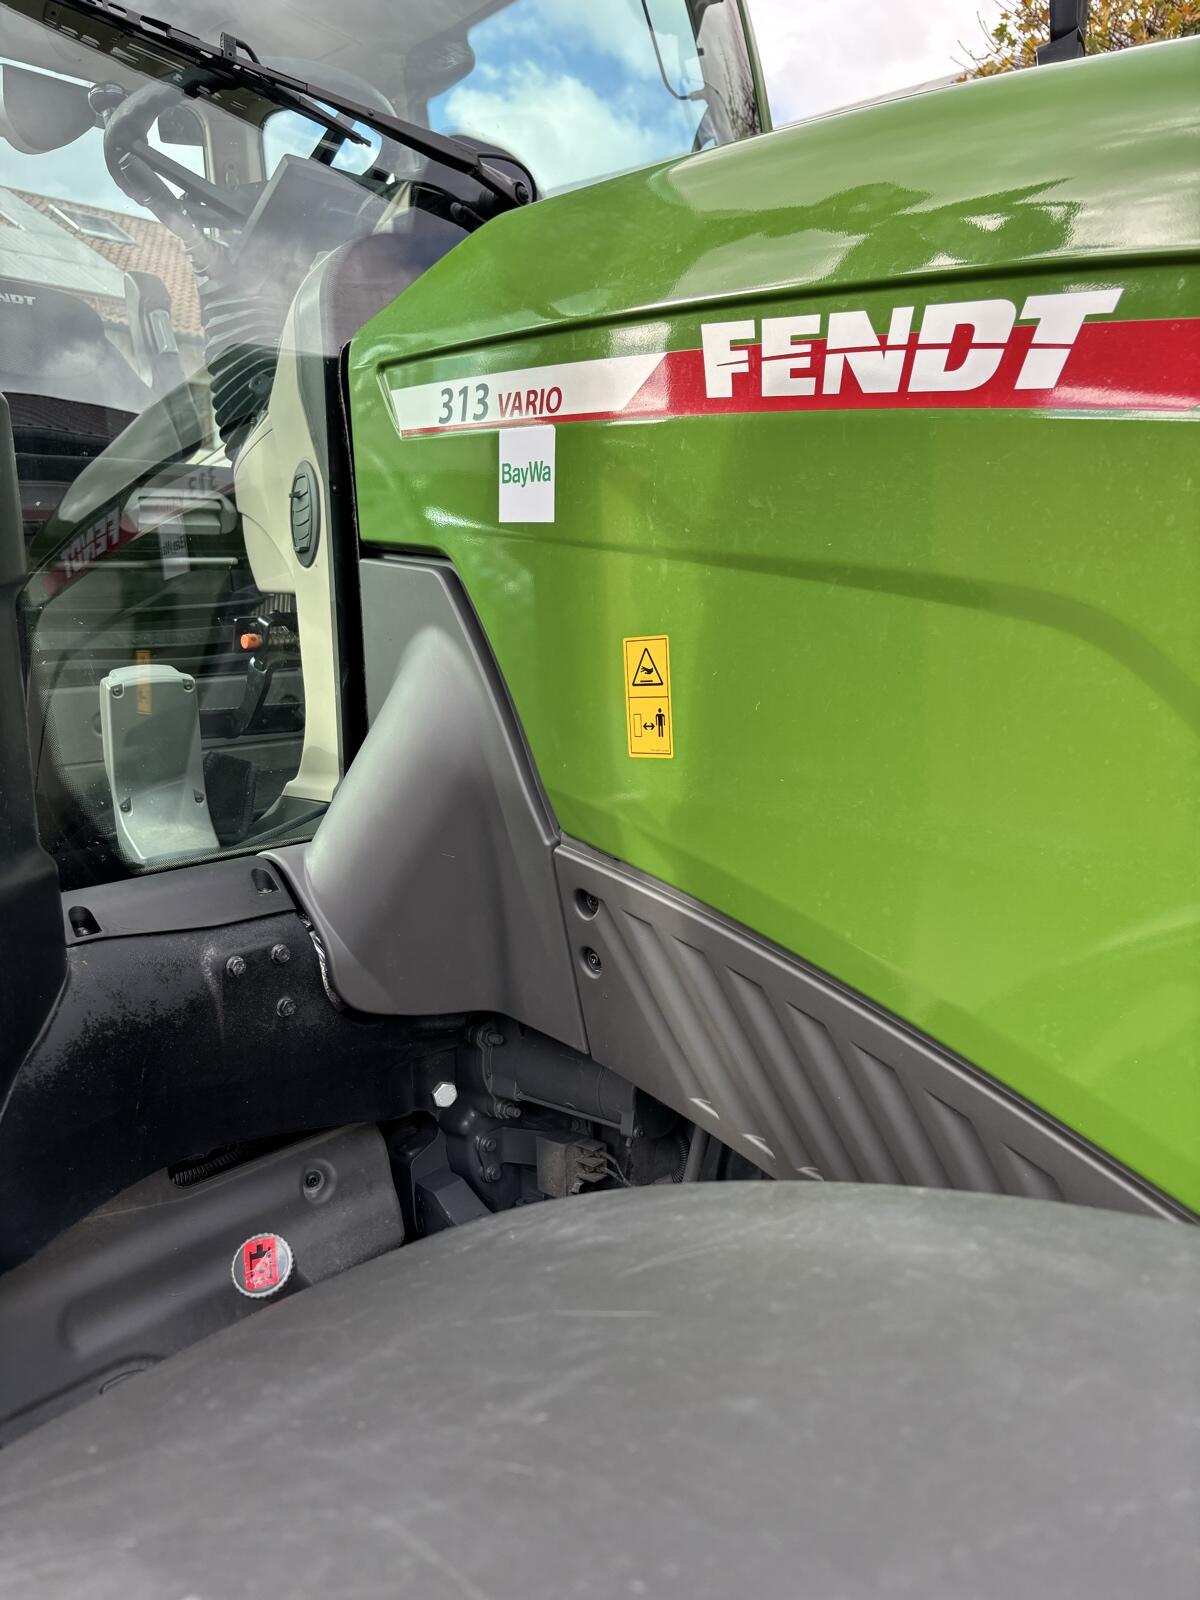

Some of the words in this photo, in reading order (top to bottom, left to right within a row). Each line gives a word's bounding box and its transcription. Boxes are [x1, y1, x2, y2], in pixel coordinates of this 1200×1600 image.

[701, 288, 1124, 398] FENDT
[438, 383, 489, 424] 313
[498, 386, 562, 417] VARIO
[501, 460, 551, 488] BayWa
